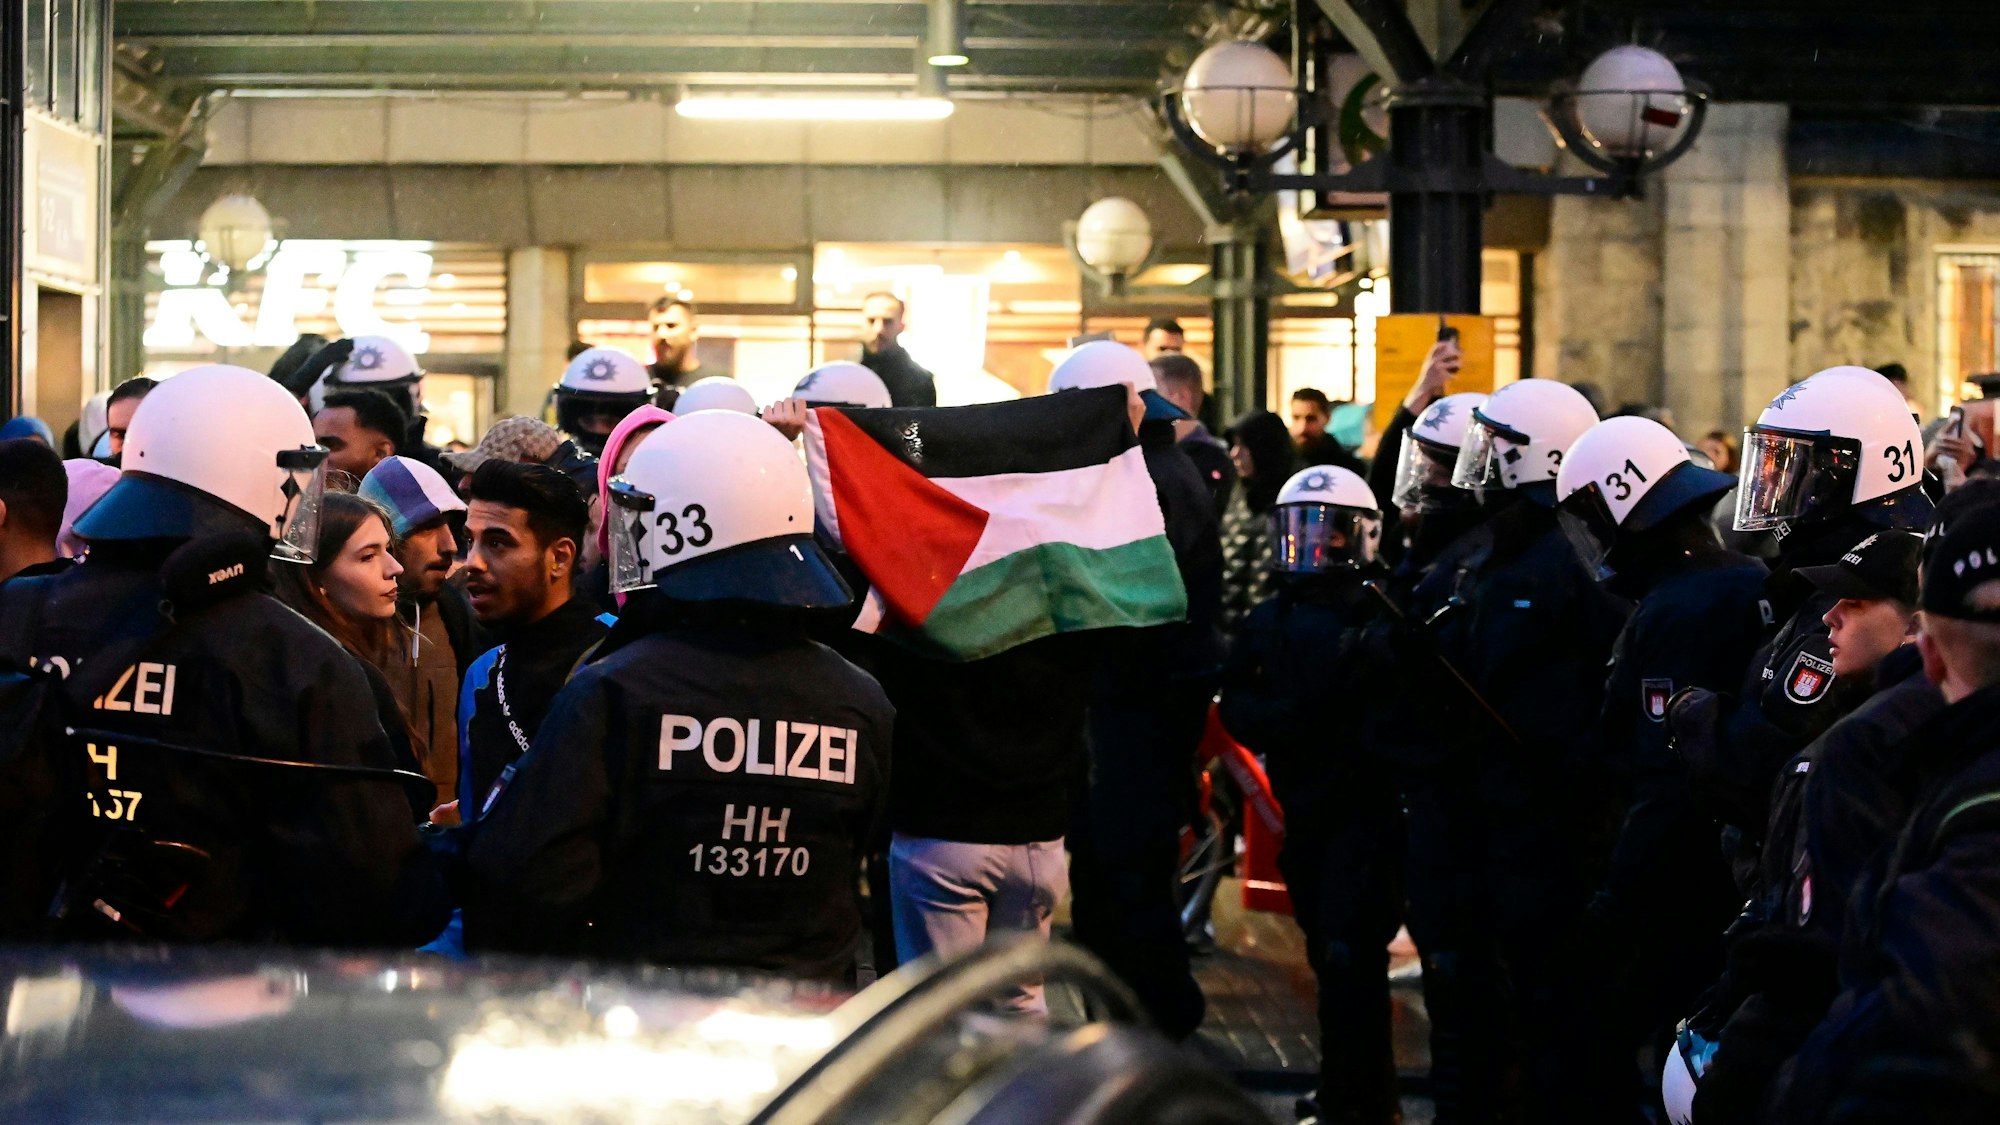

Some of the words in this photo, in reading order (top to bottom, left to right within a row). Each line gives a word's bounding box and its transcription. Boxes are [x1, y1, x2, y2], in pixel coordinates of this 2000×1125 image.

[143, 249, 434, 354] KFC
[1606, 459, 1647, 500] 31
[1884, 440, 1914, 482] 31
[656, 503, 713, 556] 33
[208, 563, 244, 585] uvex
[508, 720, 531, 752] adida
[659, 714, 858, 784] POLIZEI
[722, 804, 791, 843] HH
[689, 843, 810, 878] 133170
